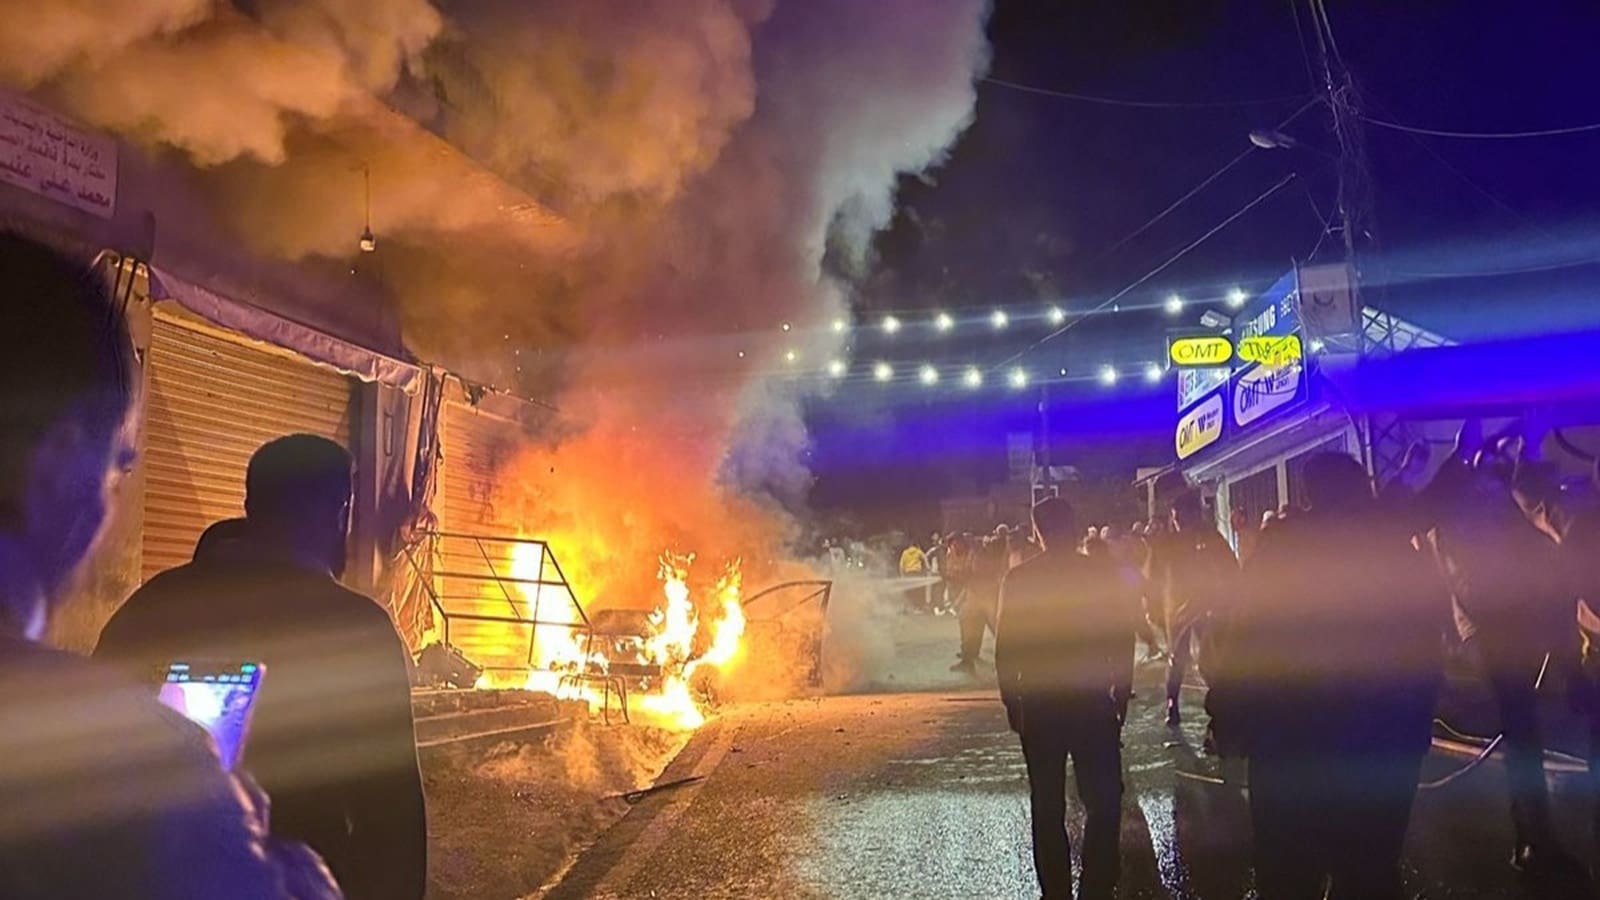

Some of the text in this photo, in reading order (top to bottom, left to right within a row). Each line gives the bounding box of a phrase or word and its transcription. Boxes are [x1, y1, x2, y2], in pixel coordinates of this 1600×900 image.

[78, 187, 111, 208] محمد
[1179, 342, 1222, 359] OMT
[1241, 378, 1261, 413] OMT
